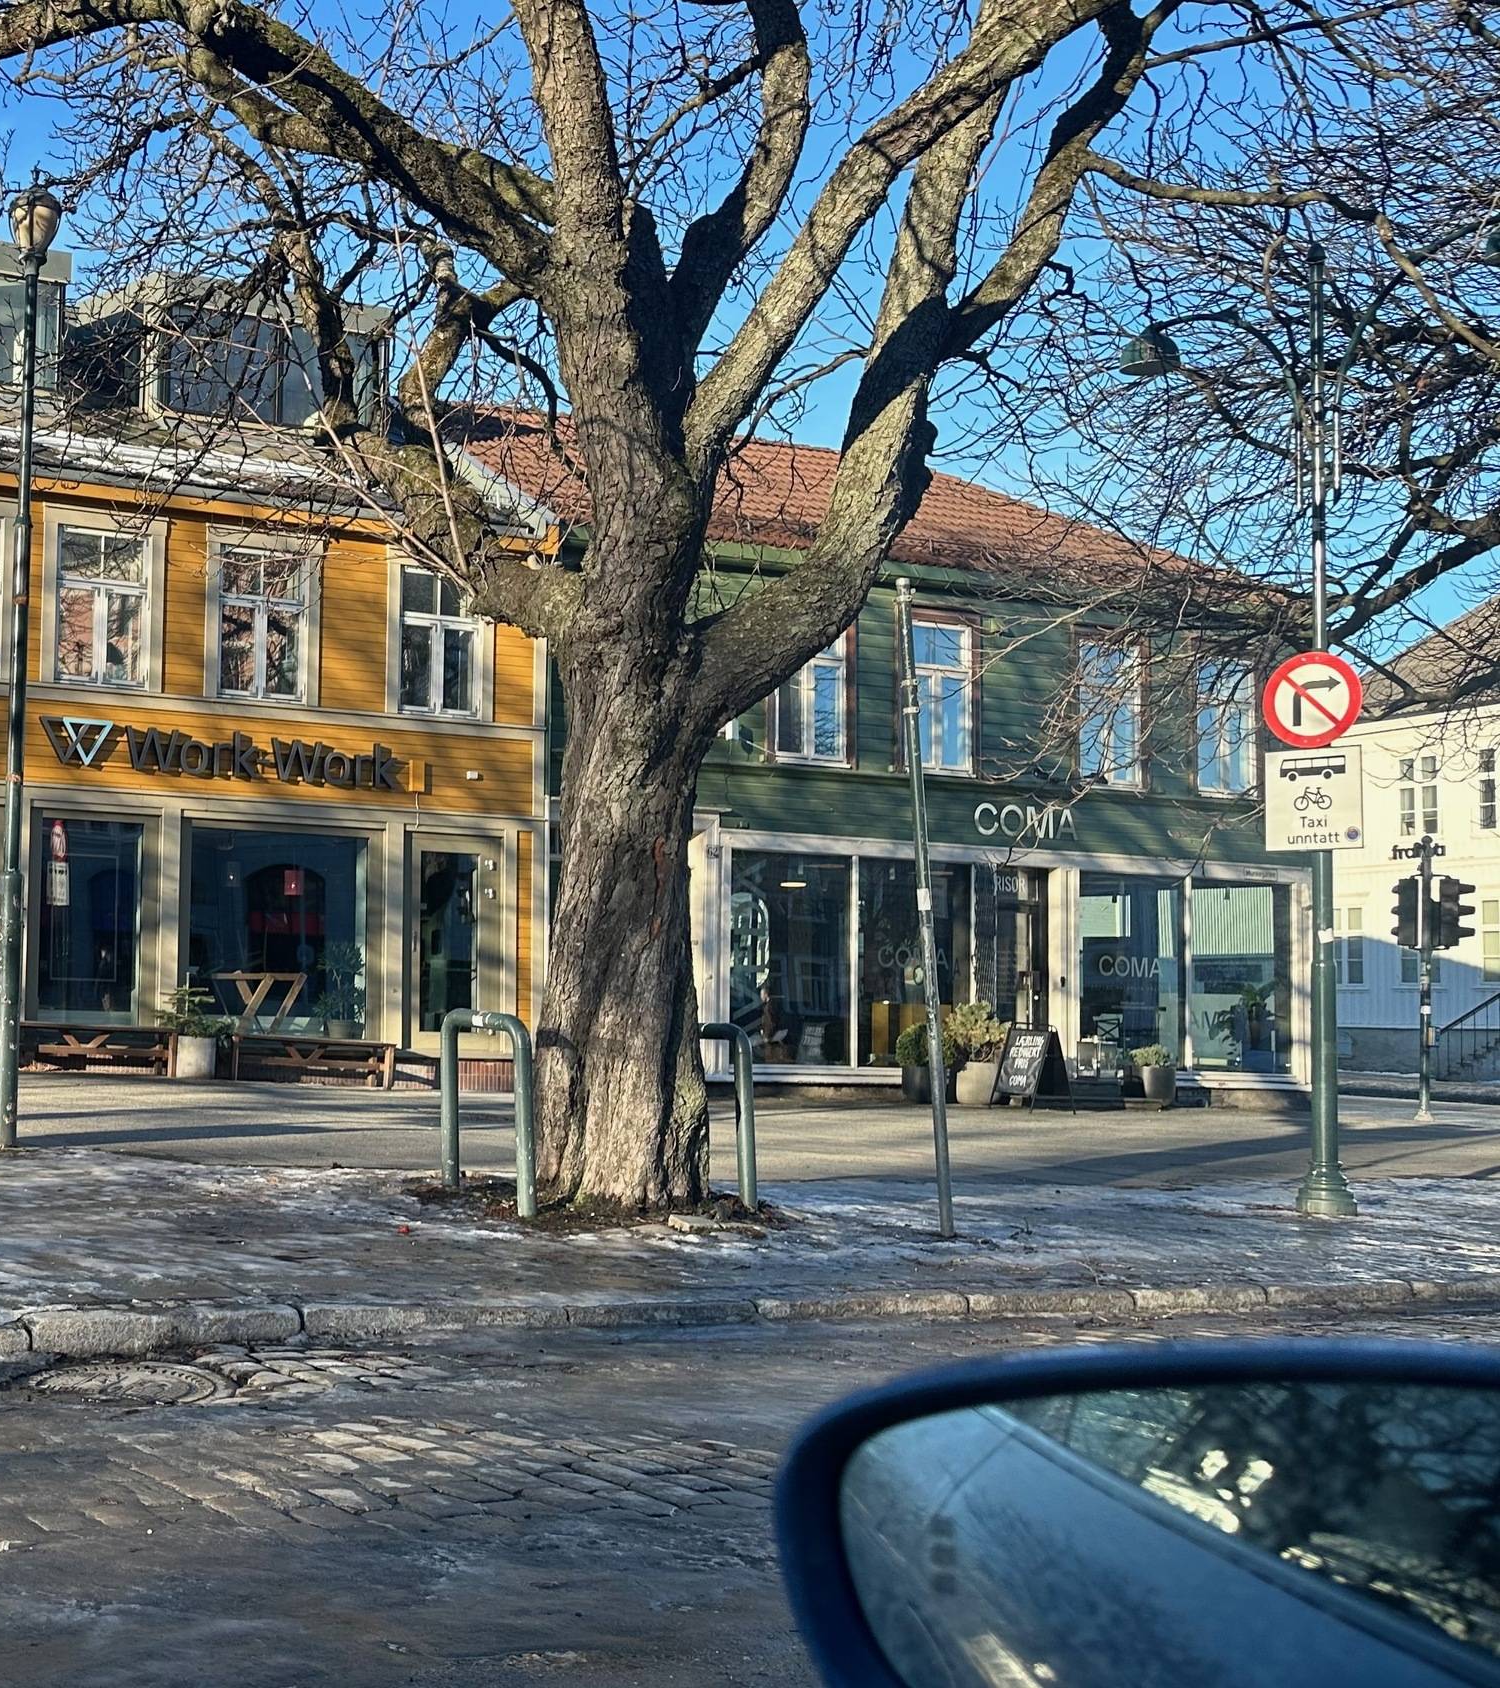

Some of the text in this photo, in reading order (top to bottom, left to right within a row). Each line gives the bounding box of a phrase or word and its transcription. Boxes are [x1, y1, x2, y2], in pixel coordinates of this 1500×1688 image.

[126, 725, 397, 789] Work-Work
[974, 802, 1078, 840] COMA
[1299, 815, 1328, 828] Taxi
[1287, 832, 1340, 844] unntatt
[878, 945, 949, 970] COA
[1098, 955, 1164, 978] COMA
[1009, 1075, 1027, 1088] COMA
